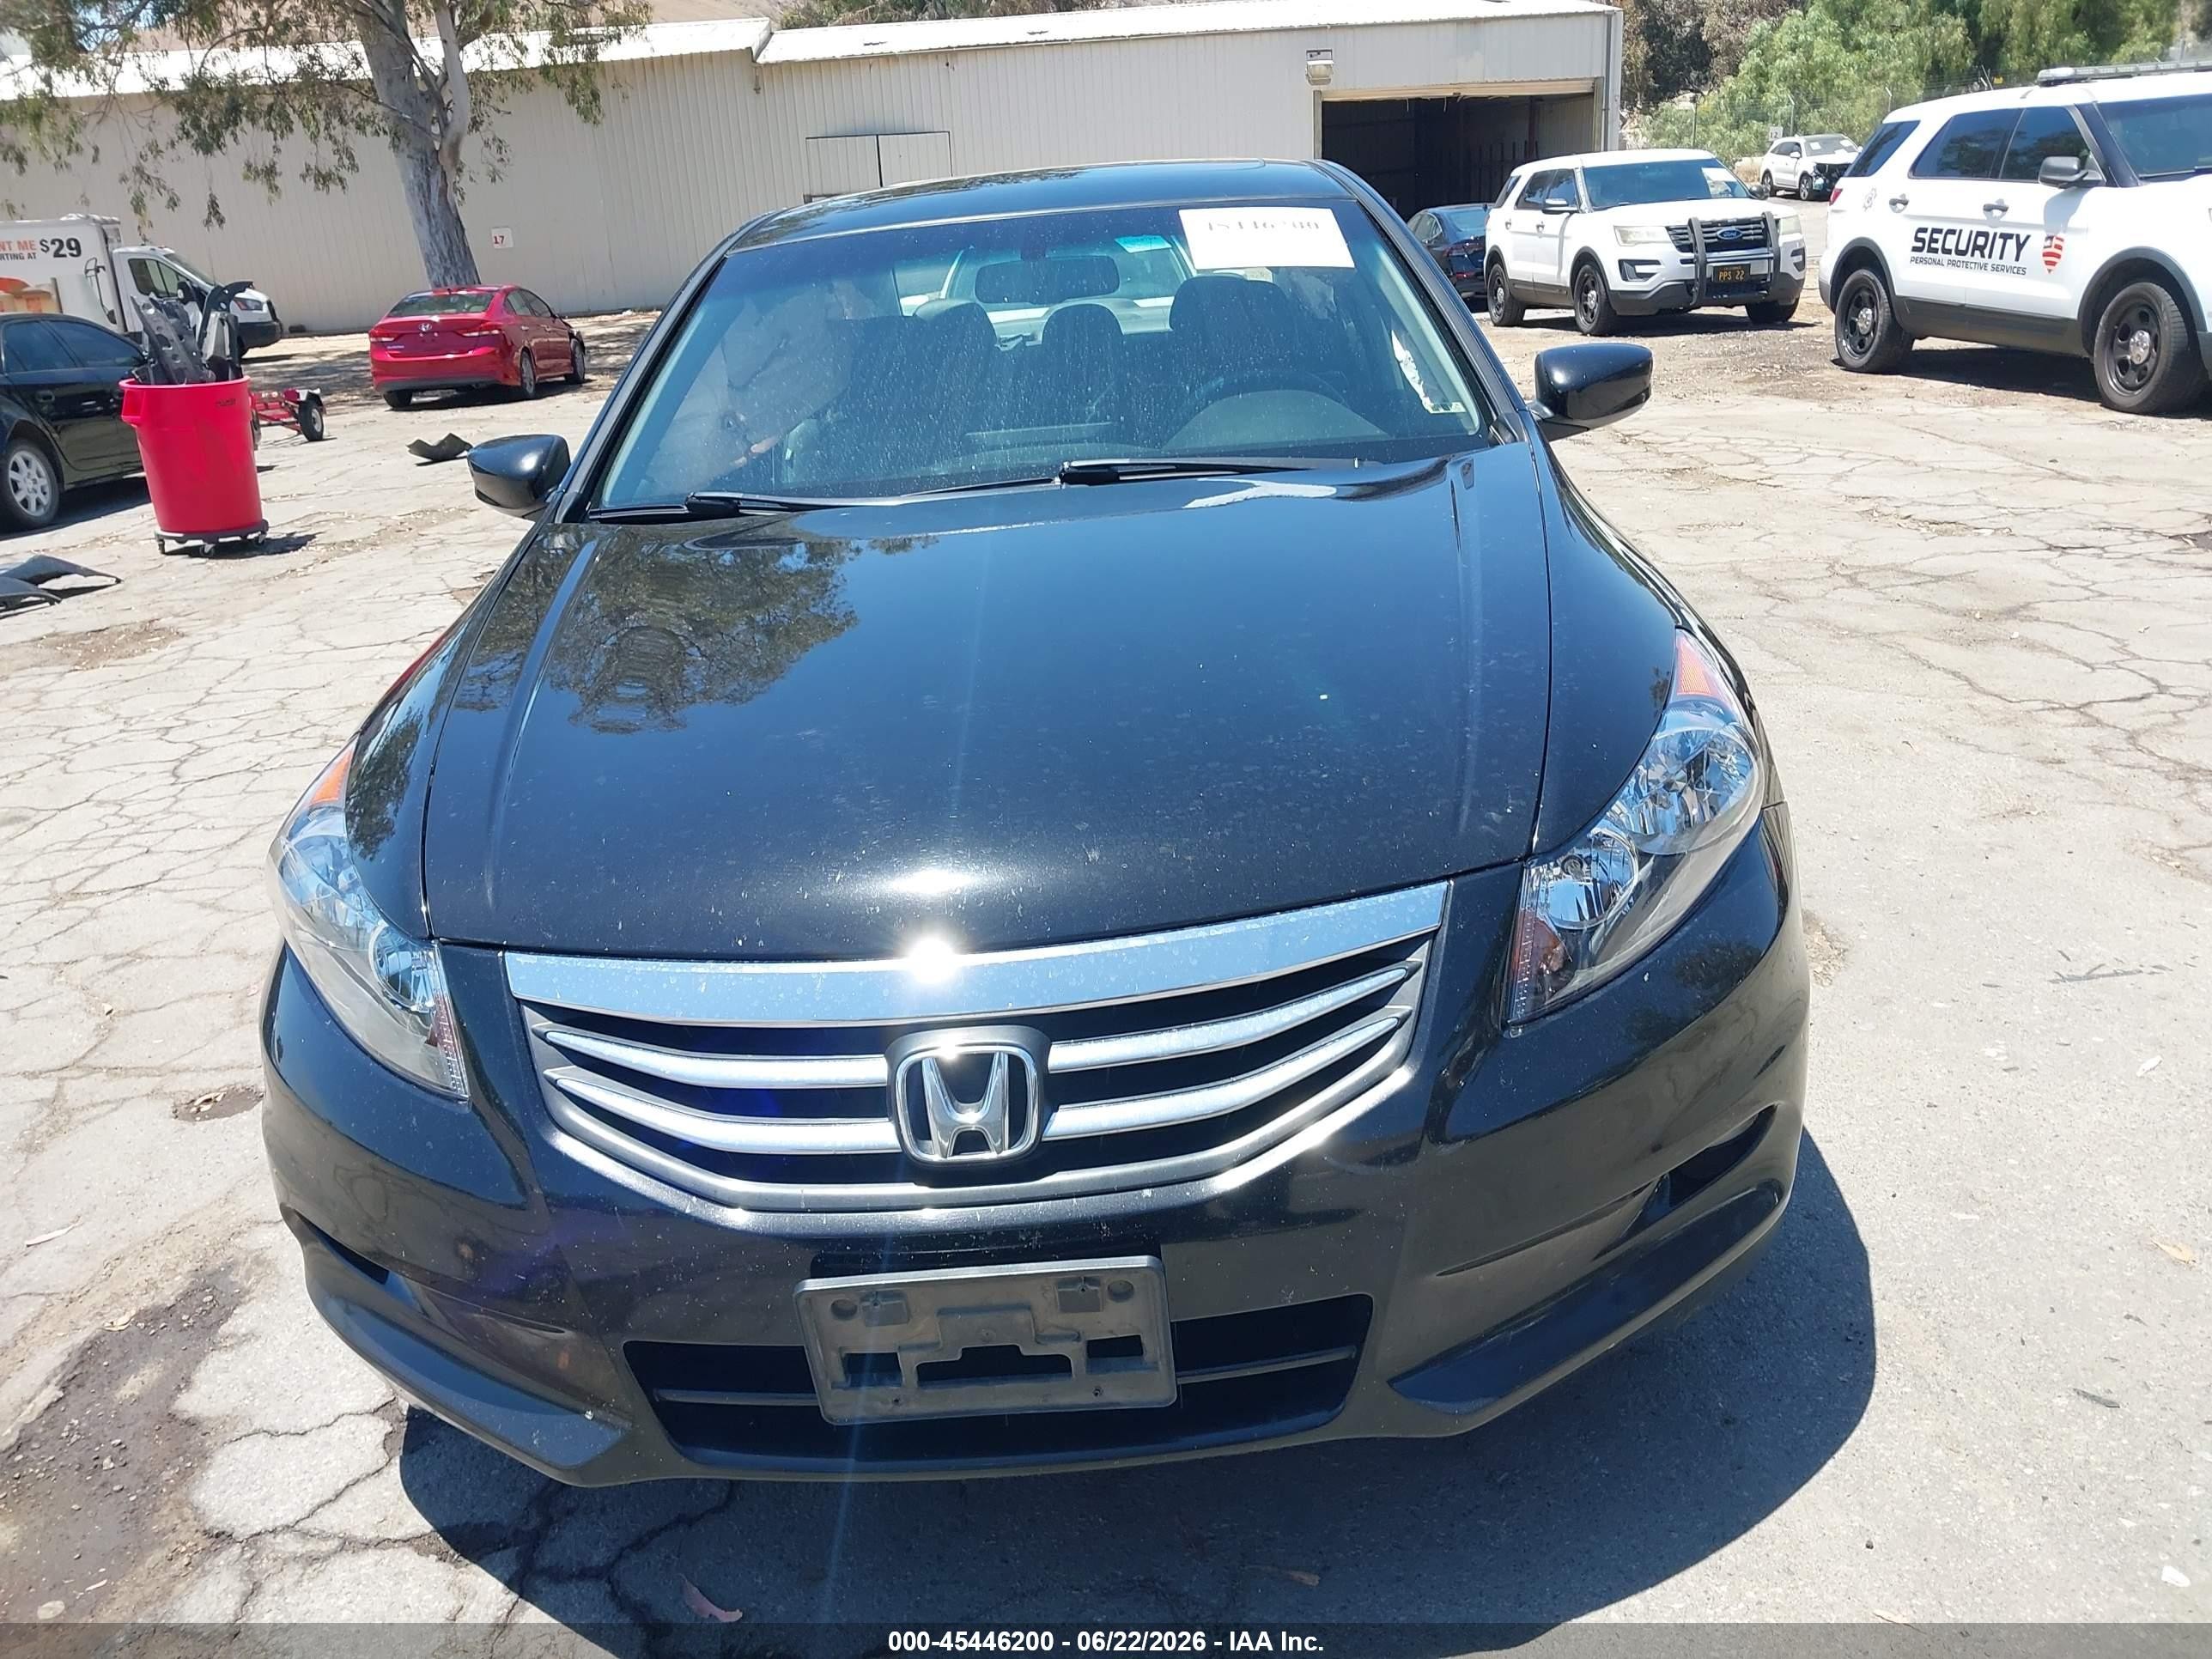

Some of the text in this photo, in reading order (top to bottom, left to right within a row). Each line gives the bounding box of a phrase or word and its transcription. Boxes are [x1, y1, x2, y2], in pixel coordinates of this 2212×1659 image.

[17, 240, 36, 250] ME
[40, 238, 82, 258] $29
[494, 235, 505, 245] 17
[1911, 227, 2032, 262] SECURITY
[1719, 270, 1745, 282] PPS 22
[1910, 256, 2027, 276] PERSONAL PROTECTIVE SERVICES
